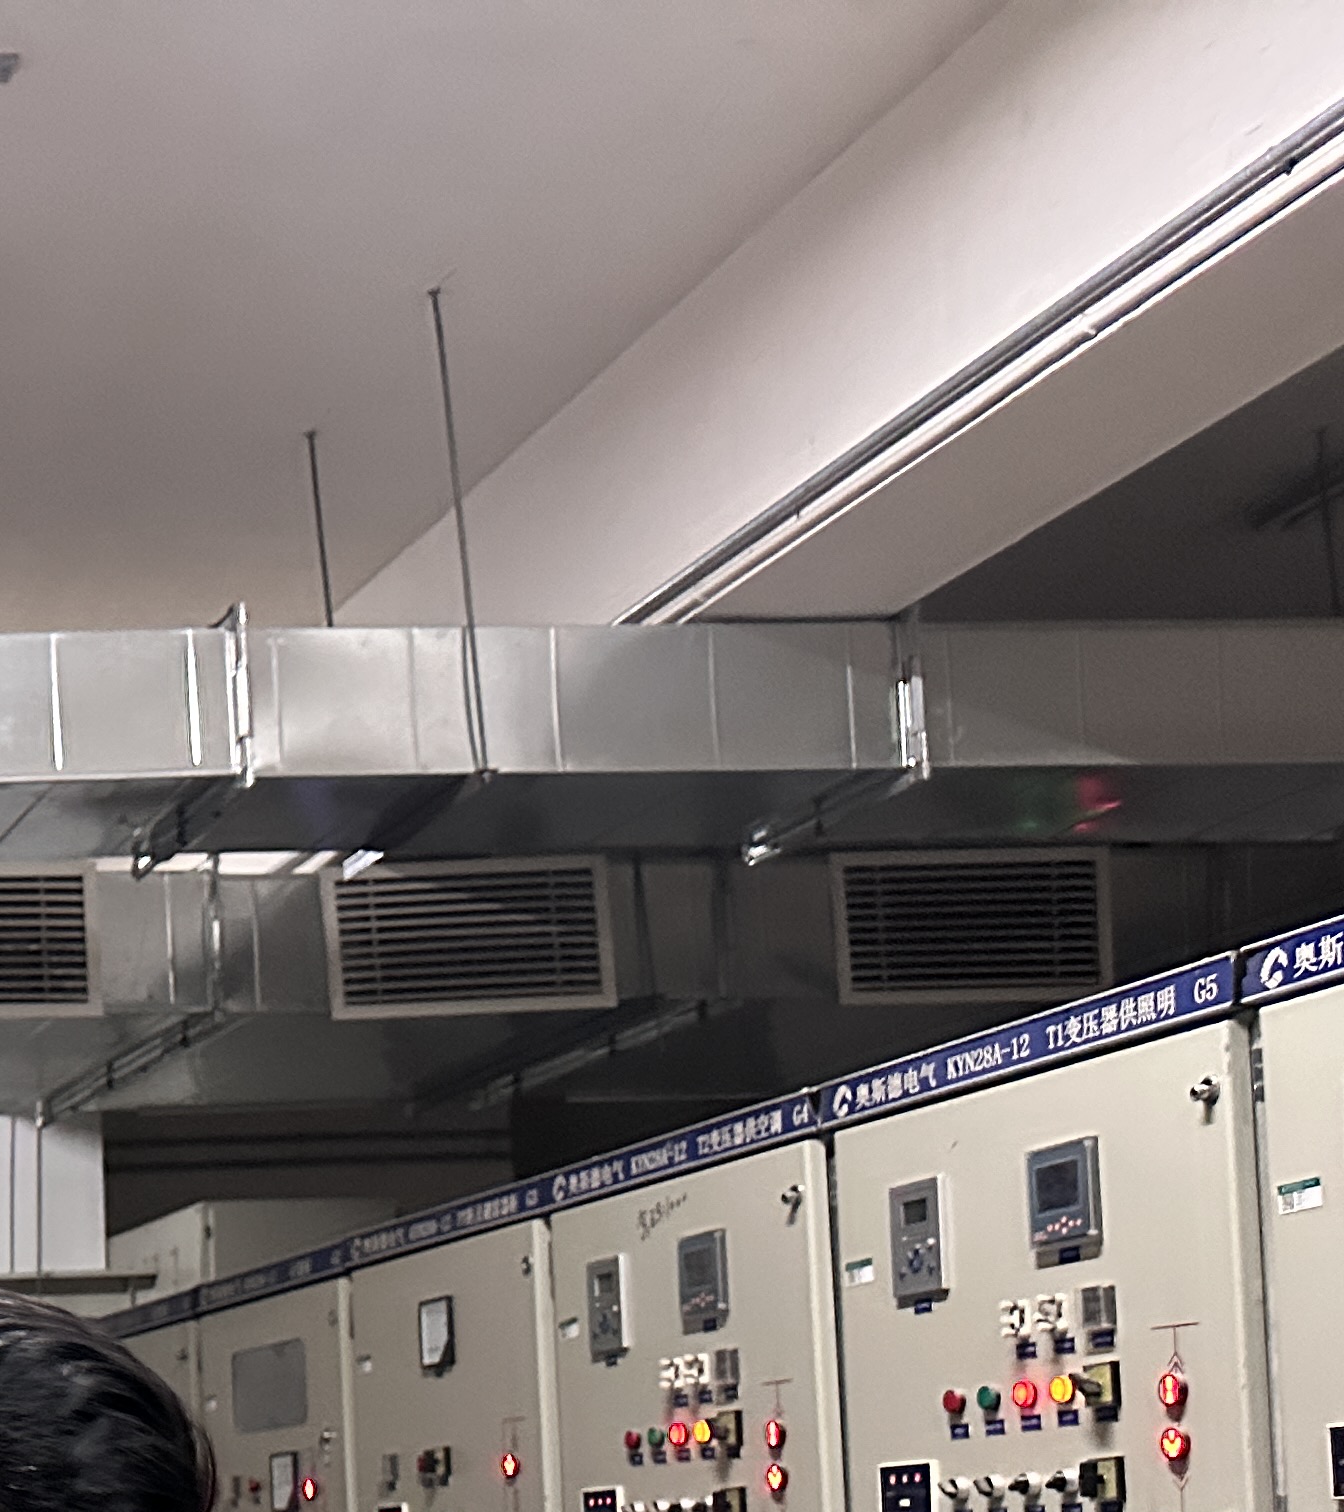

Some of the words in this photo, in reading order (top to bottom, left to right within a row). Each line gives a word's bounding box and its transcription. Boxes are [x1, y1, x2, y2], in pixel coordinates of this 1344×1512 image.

[855, 1061, 936, 1111] 奥斯德电气
[946, 1033, 1031, 1080] KYN28A-12
[1194, 974, 1219, 1004] G5
